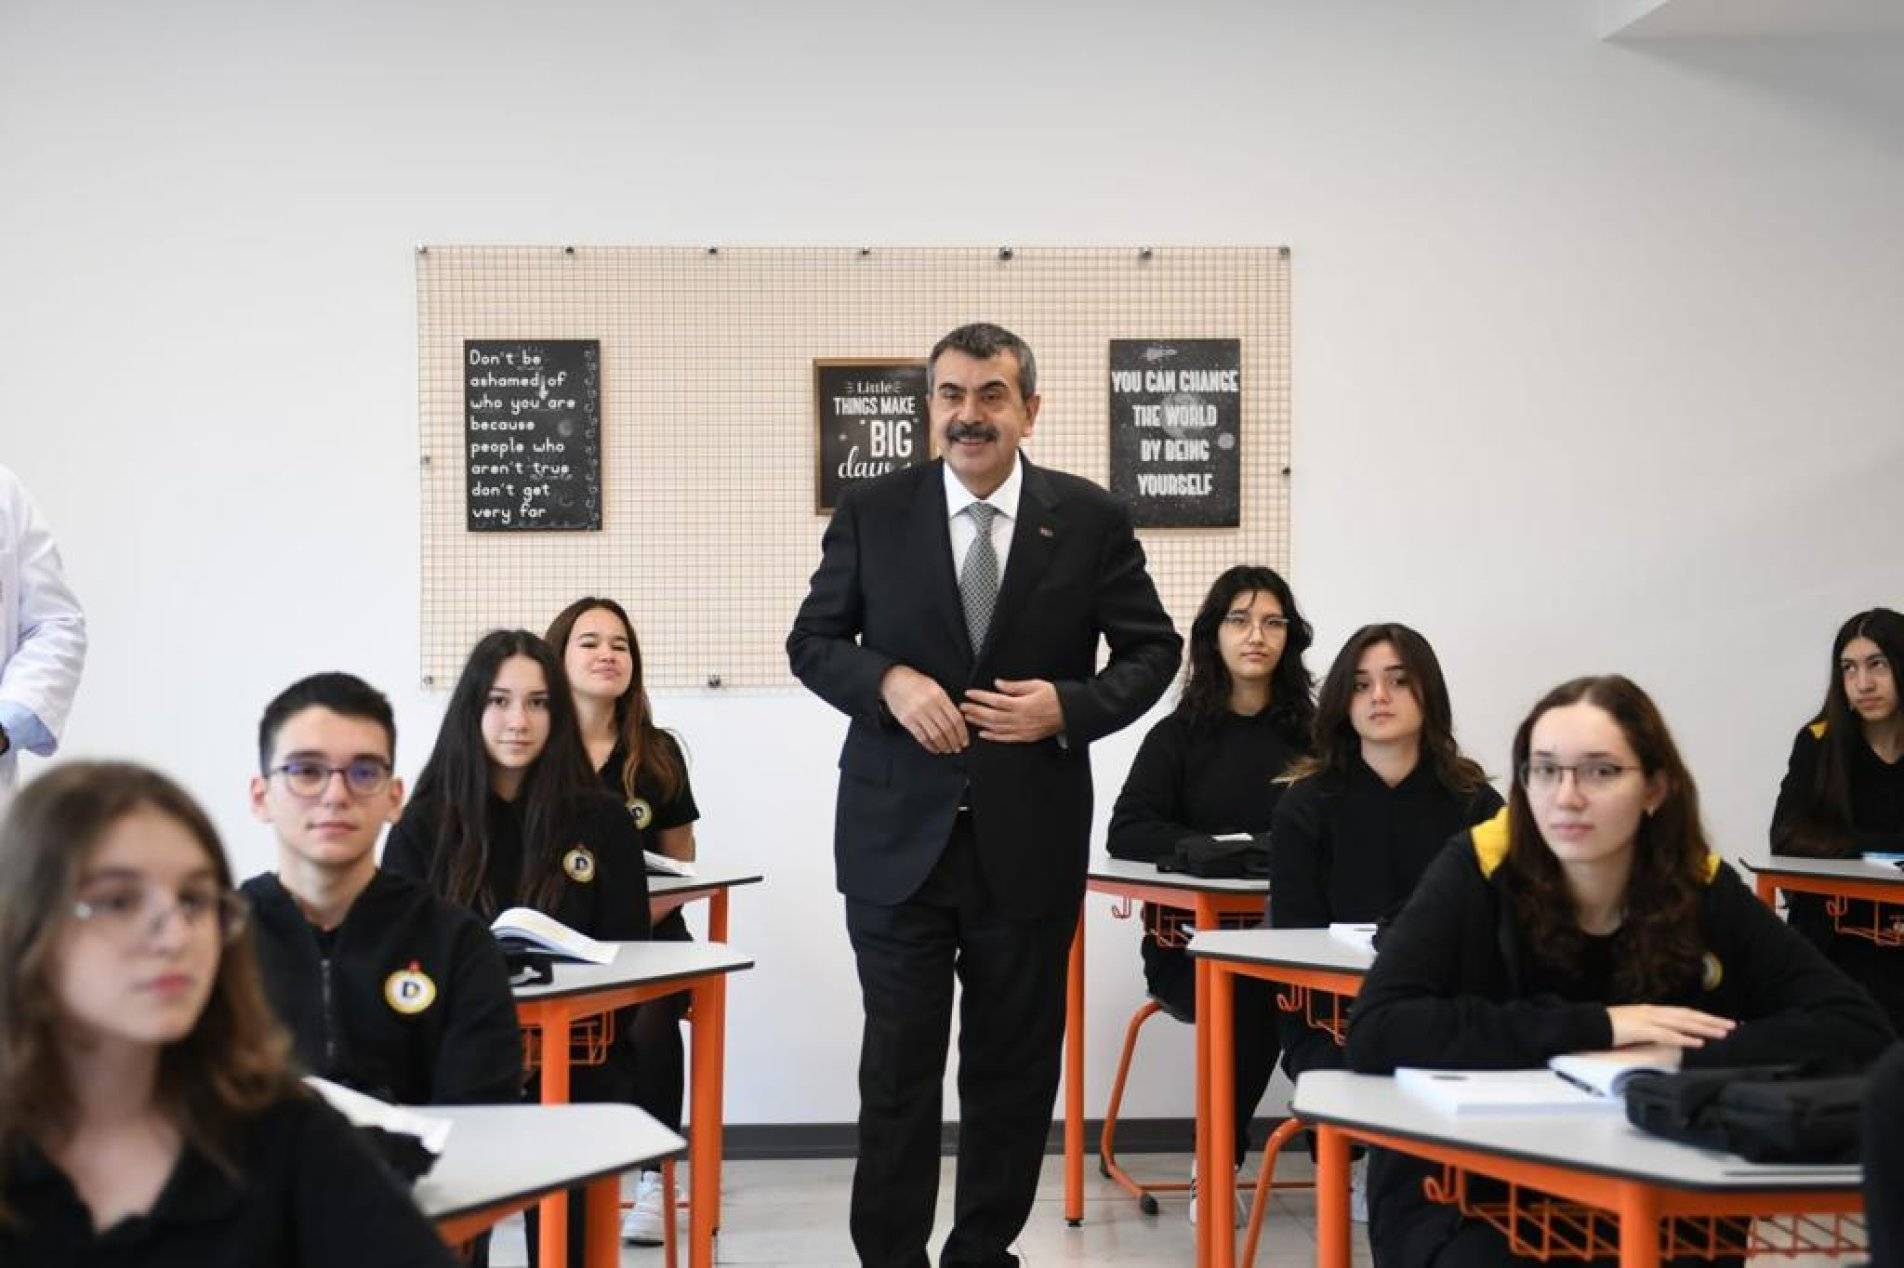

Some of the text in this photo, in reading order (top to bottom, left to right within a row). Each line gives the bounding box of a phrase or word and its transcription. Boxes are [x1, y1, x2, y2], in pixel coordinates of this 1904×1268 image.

[469, 349, 542, 365] Don't be
[469, 370, 567, 387] ashamed of
[856, 380, 893, 394] Little
[1112, 370, 1239, 393] YOU CAN CHANGE
[470, 393, 576, 415] who you are
[833, 396, 916, 416] THINGS MAKE
[470, 415, 535, 431] because
[1132, 405, 1218, 427] THE WORLD
[471, 436, 565, 459] people who
[870, 420, 913, 458] BIG
[1140, 439, 1210, 462] BY BEING
[471, 461, 570, 474] aren't true
[471, 480, 550, 503] don't get
[1136, 474, 1213, 497] YOURSELF
[472, 501, 547, 525] very far
[402, 981, 421, 998] D
